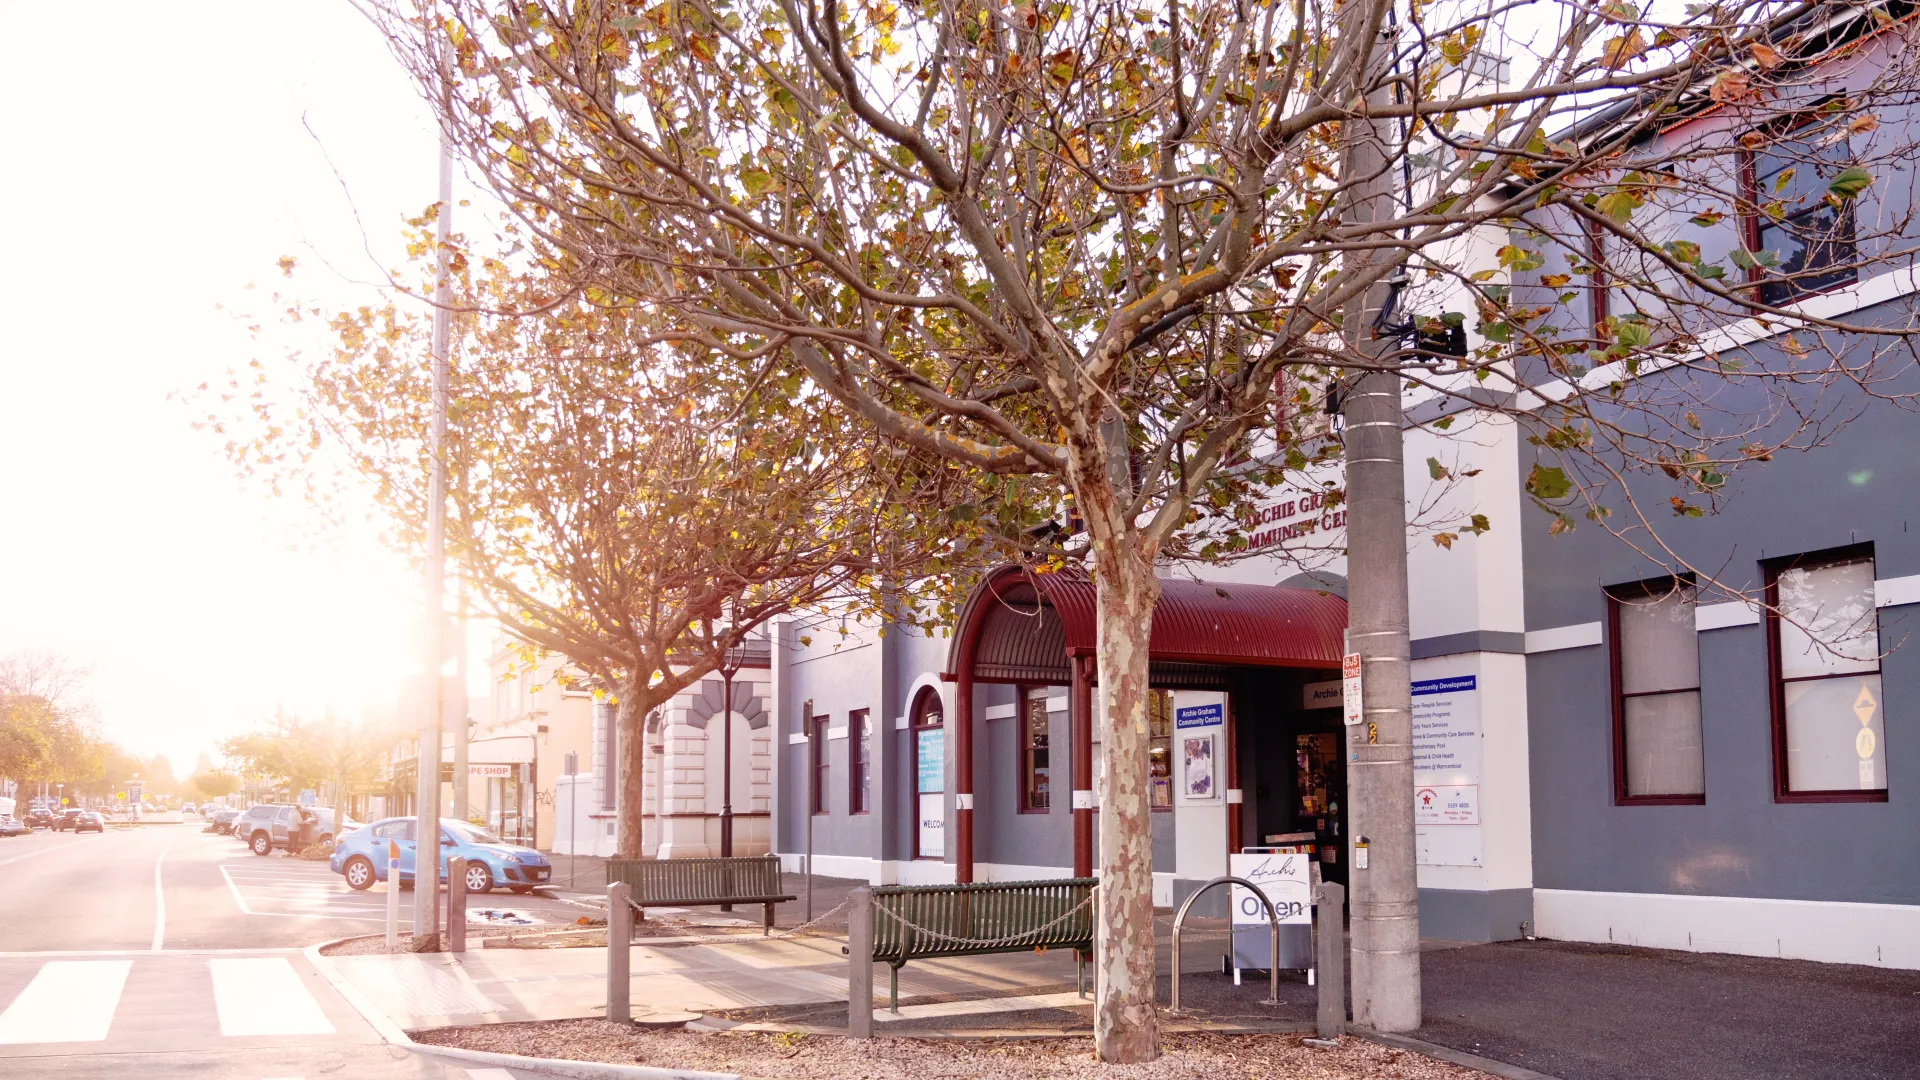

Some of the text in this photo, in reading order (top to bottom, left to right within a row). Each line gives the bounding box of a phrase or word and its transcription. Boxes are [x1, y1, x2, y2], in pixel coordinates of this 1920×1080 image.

[1234, 518, 1316, 552] MMUNITY
[1345, 656, 1358, 667] BUS
[1344, 667, 1360, 678] ZONE
[1411, 680, 1473, 692] Community Development
[1313, 688, 1337, 699] Archie
[1182, 707, 1216, 718] Archie Graham
[1178, 715, 1220, 726] Community Centre
[484, 767, 508, 775] SHOP
[1241, 896, 1302, 920] Open
